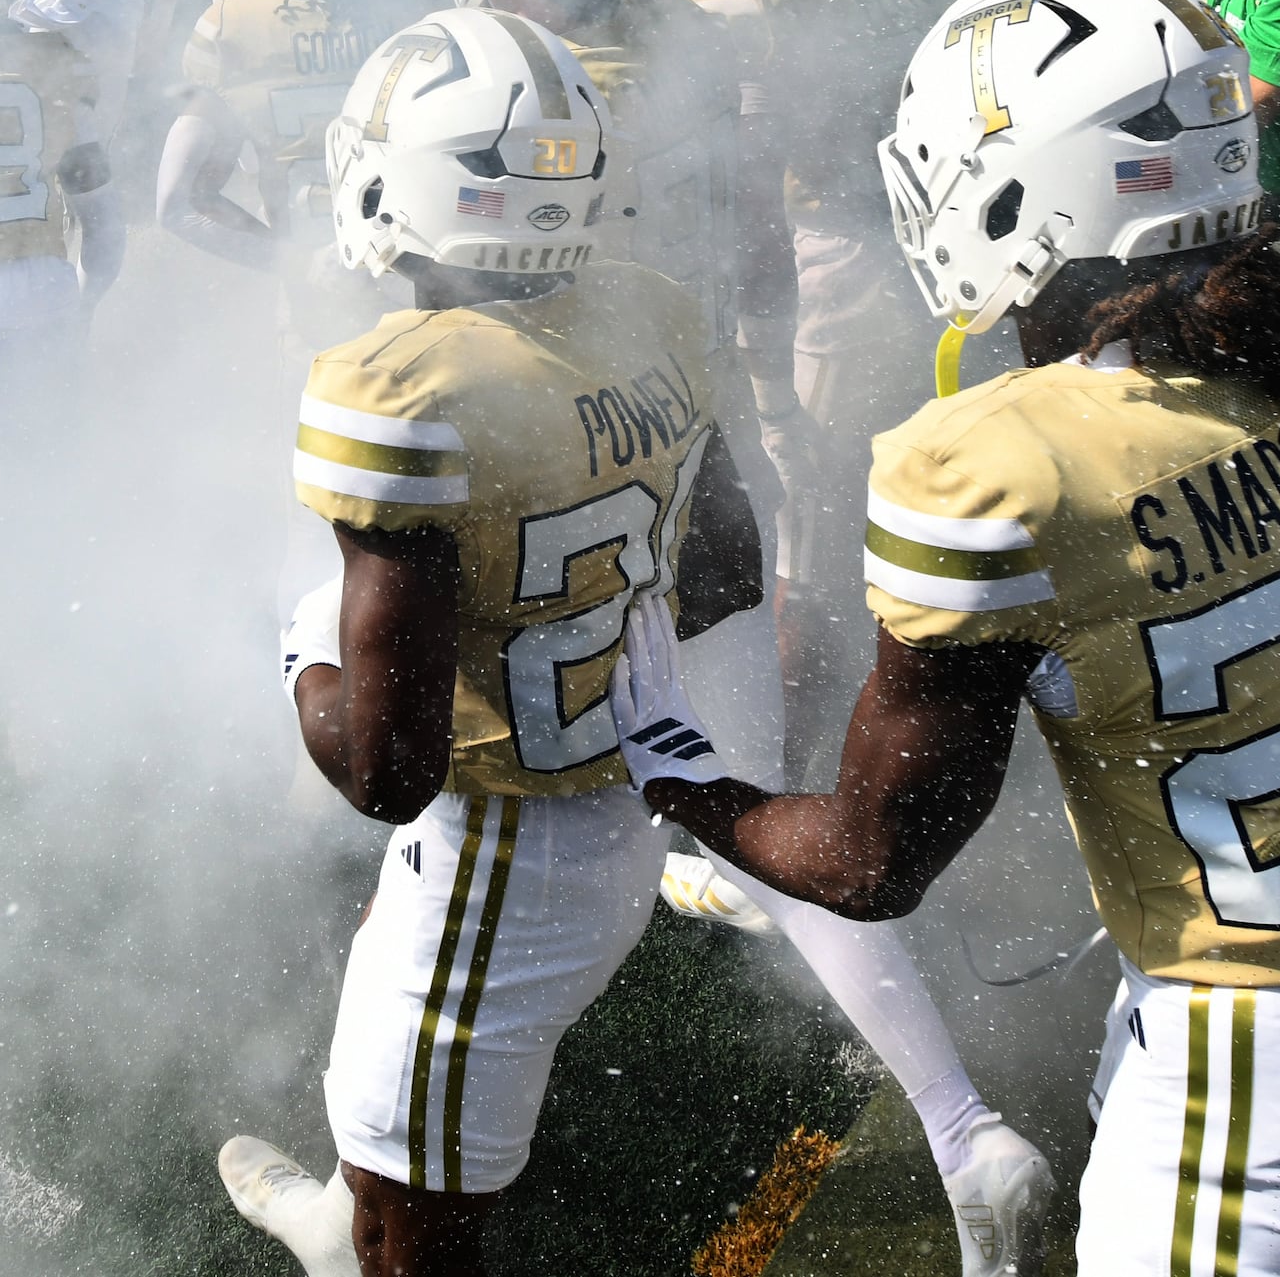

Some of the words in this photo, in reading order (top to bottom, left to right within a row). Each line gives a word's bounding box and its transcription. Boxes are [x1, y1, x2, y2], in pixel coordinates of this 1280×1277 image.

[953, 1, 1023, 30] GEORGIA
[977, 29, 988, 96] TECH
[535, 138, 577, 174] 20
[475, 243, 592, 270] JACKETS
[573, 352, 702, 478] POWELL
